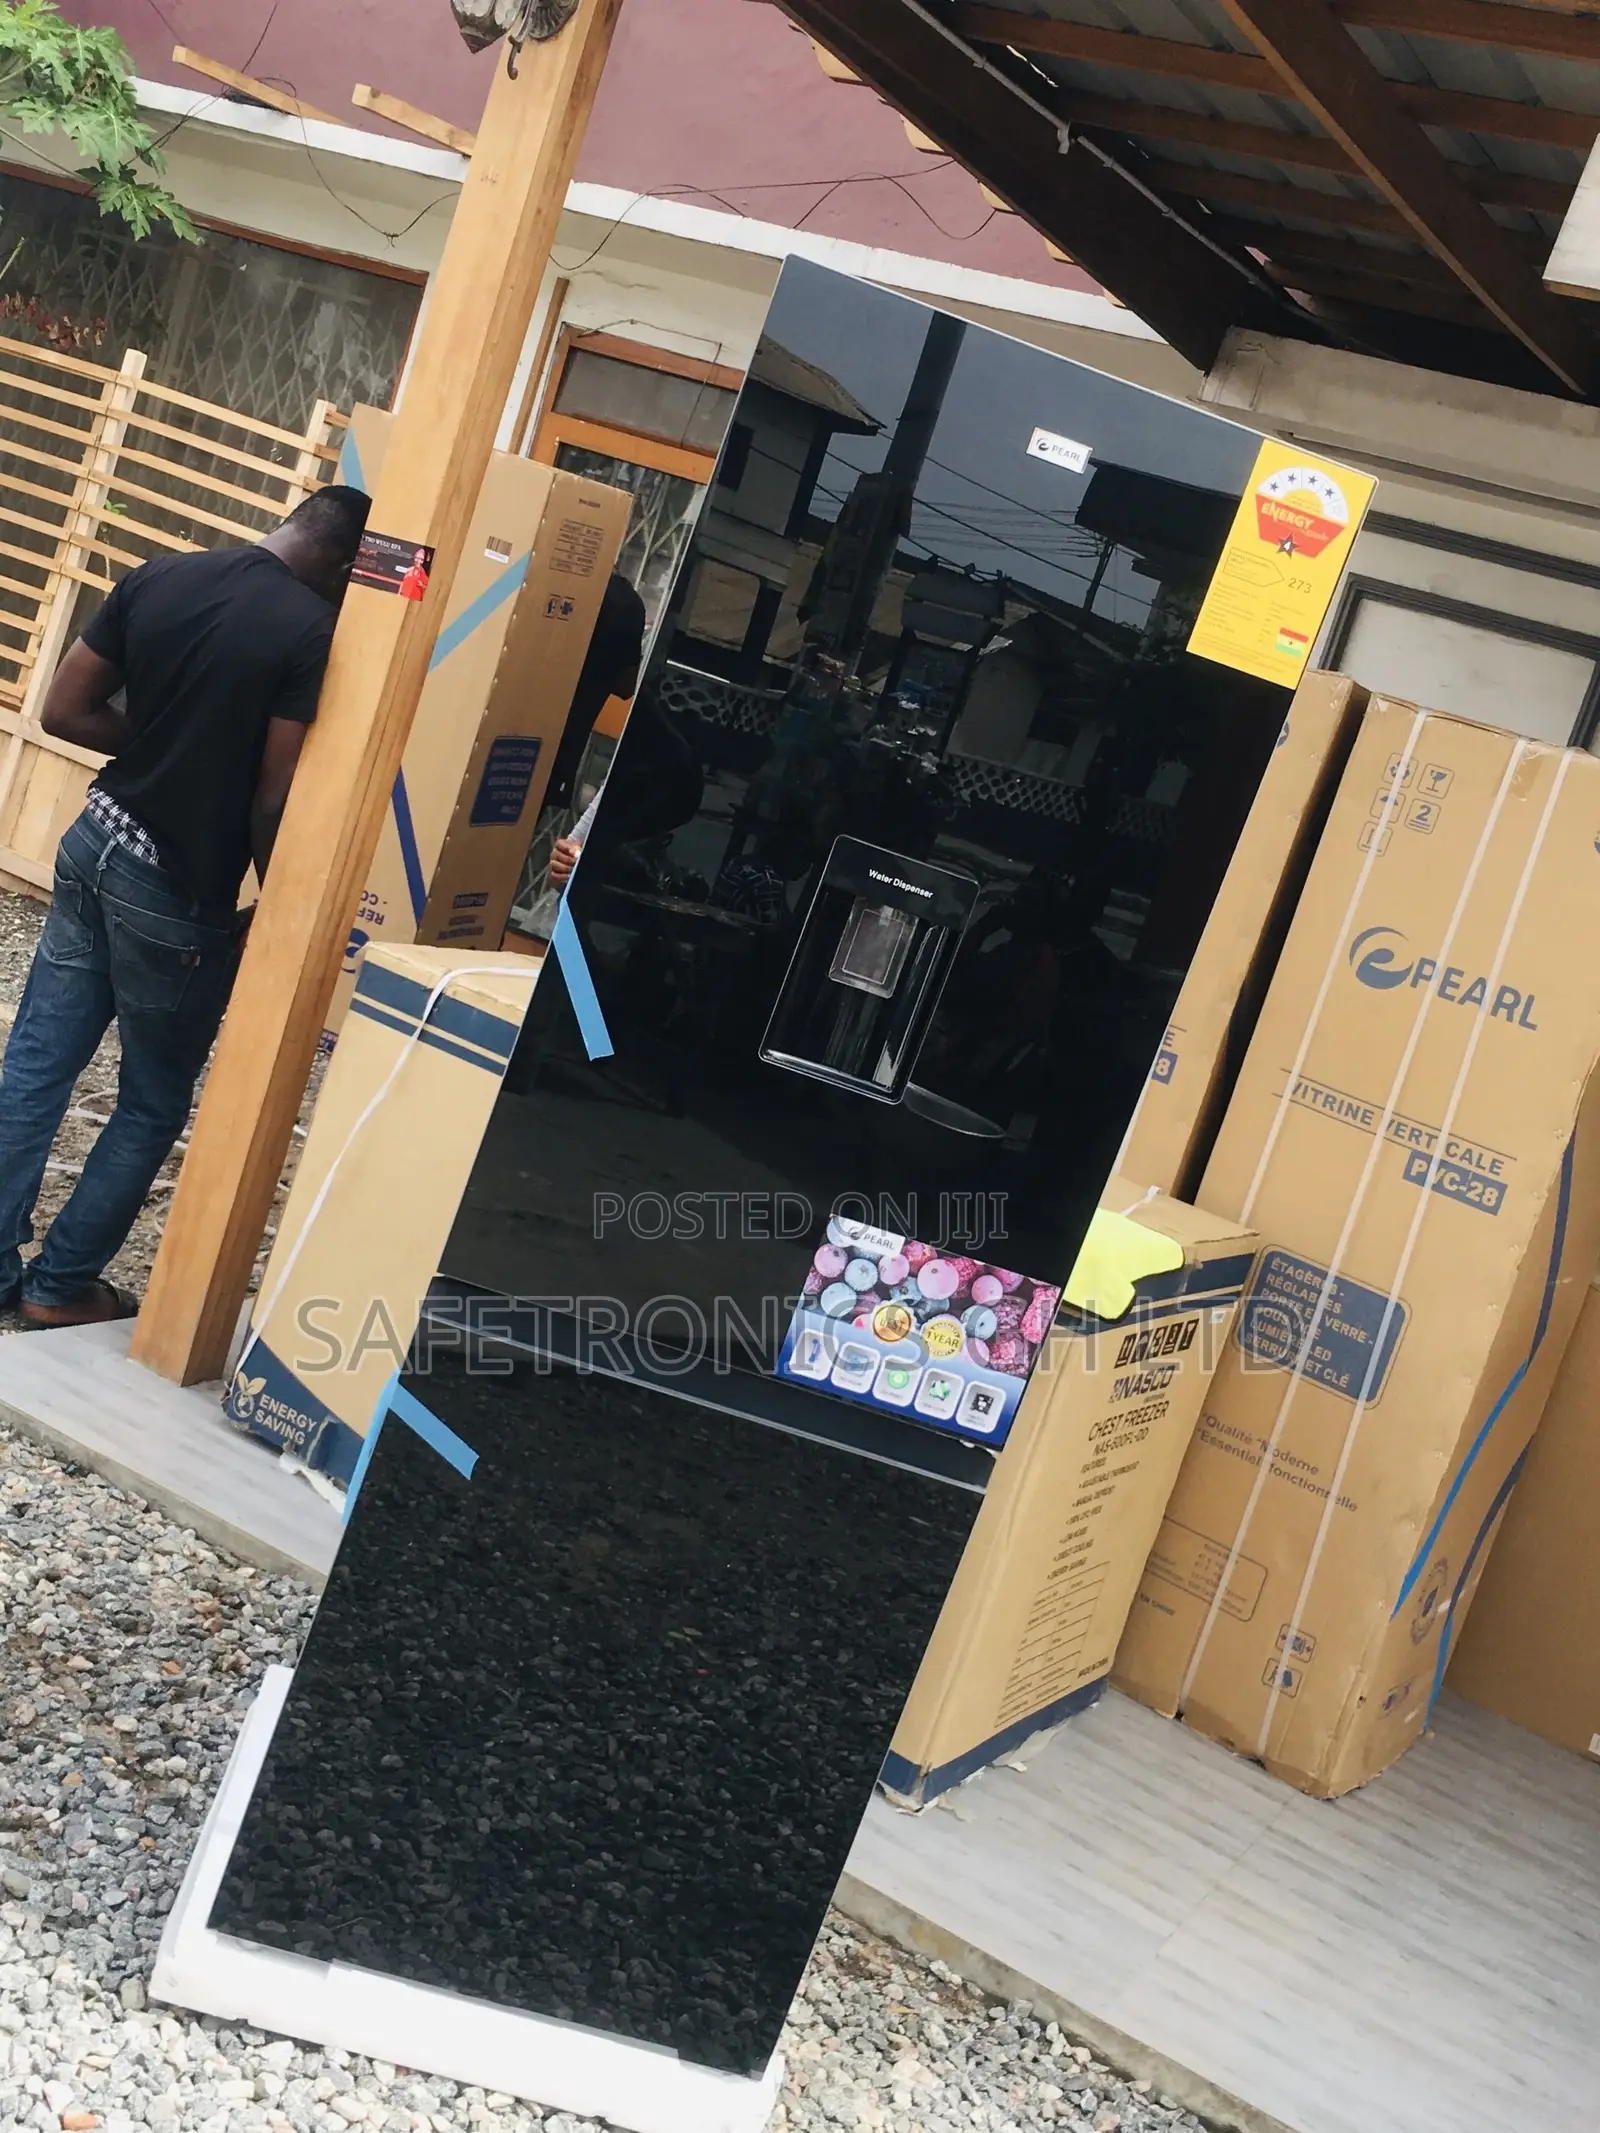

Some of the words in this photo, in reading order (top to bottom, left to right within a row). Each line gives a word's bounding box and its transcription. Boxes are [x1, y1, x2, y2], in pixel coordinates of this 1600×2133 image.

[1051, 444, 1082, 463] PEARL
[1261, 499, 1315, 530] ENERGY
[1288, 577, 1312, 594] 273
[1416, 804, 1431, 822] 2
[869, 868, 893, 884] Water
[892, 877, 934, 899] Dispenser
[1410, 957, 1538, 1031] PEARL
[1385, 1118, 1506, 1176] VERTCALE
[864, 1233, 895, 1250] PEARL
[1271, 1256, 1339, 1295] ÉTAGÈRS
[1265, 1273, 1344, 1314] RÉGLABES
[933, 1331, 960, 1348] YEAR
[1325, 1315, 1369, 1345] VERRE
[1245, 1334, 1298, 1361] SERRUR
[1305, 1359, 1322, 1374] ET
[1323, 1368, 1351, 1388] CLÉ
[1119, 1365, 1175, 1399] NASCO
[254, 1409, 306, 1445] SAVING
[259, 1393, 318, 1433] ENERGY
[1088, 1413, 1124, 1441] CHEST
[1123, 1400, 1170, 1427] FREEZER
